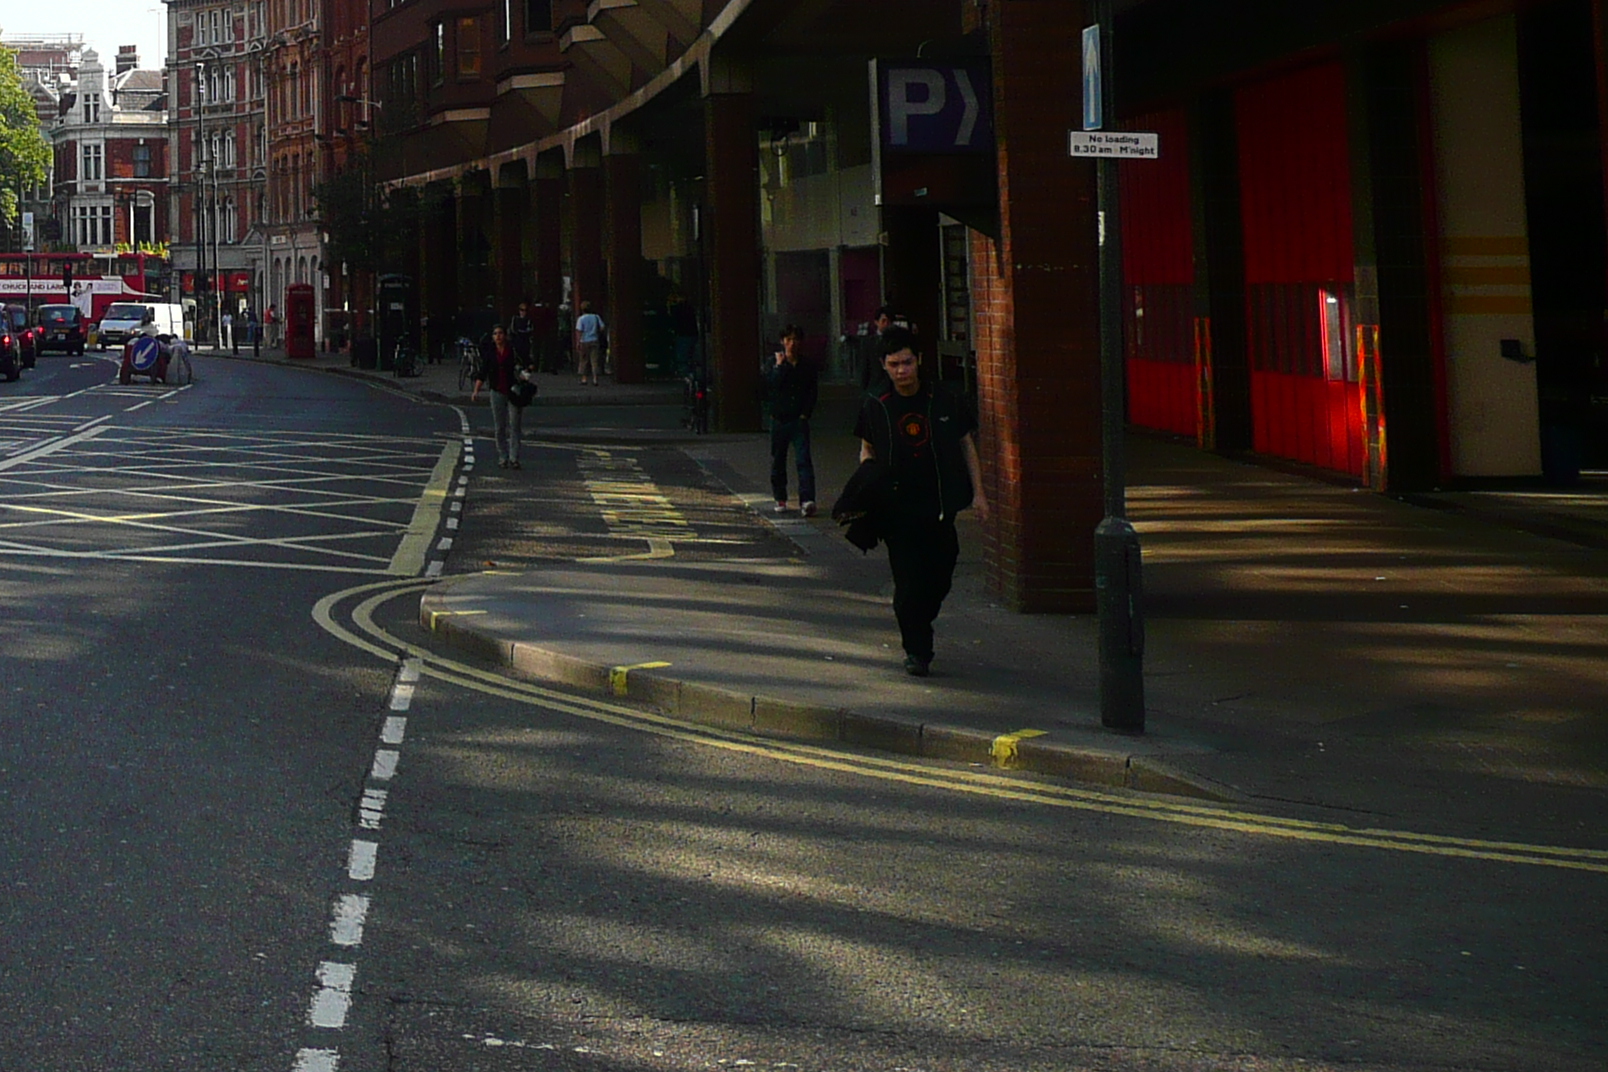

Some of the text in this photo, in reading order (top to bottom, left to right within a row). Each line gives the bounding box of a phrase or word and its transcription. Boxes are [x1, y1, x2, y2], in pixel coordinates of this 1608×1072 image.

[889, 68, 946, 145] P
[1089, 134, 1139, 145] No loading
